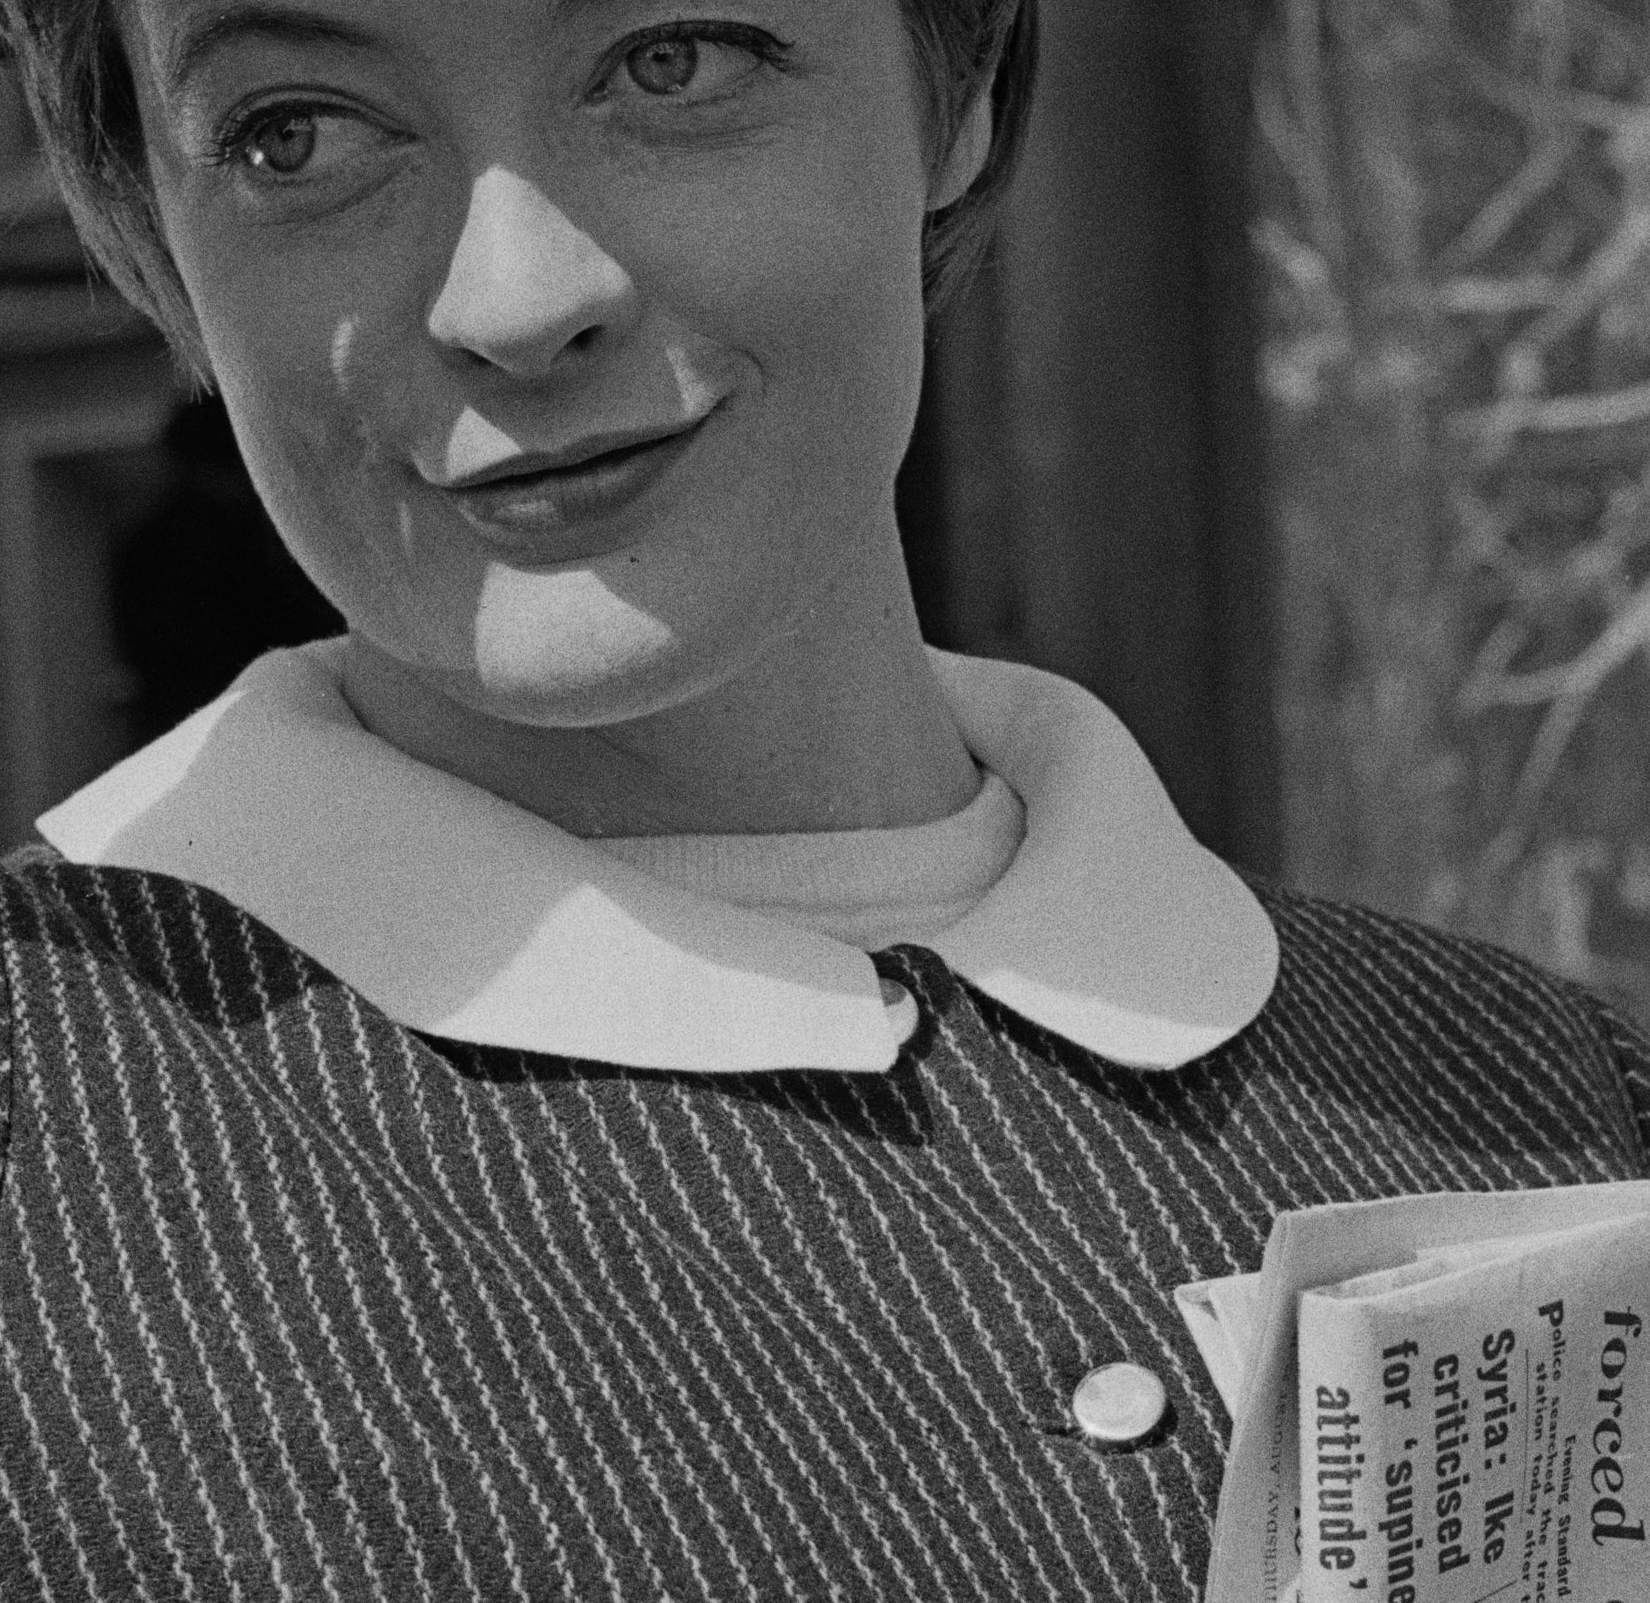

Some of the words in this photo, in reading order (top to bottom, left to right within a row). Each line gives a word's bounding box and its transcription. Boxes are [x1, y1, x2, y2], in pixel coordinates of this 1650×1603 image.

[1382, 1338, 1419, 1409] for
[1538, 1298, 1566, 1381] Police
[1477, 1329, 1516, 1470] Syria:
[1533, 1363, 1548, 1441] station
[1590, 1306, 1646, 1546] forced
[1434, 1354, 1471, 1574] criticised
[1526, 1454, 1544, 1516] today
[1543, 1395, 1561, 1495] searched
[1558, 1434, 1577, 1505] Evening
[1316, 1385, 1367, 1590] attitude’
[1538, 1508, 1552, 1546] the
[1483, 1491, 1515, 1565] Ike
[1521, 1528, 1536, 1582] after
[1557, 1513, 1572, 1596] Standard
